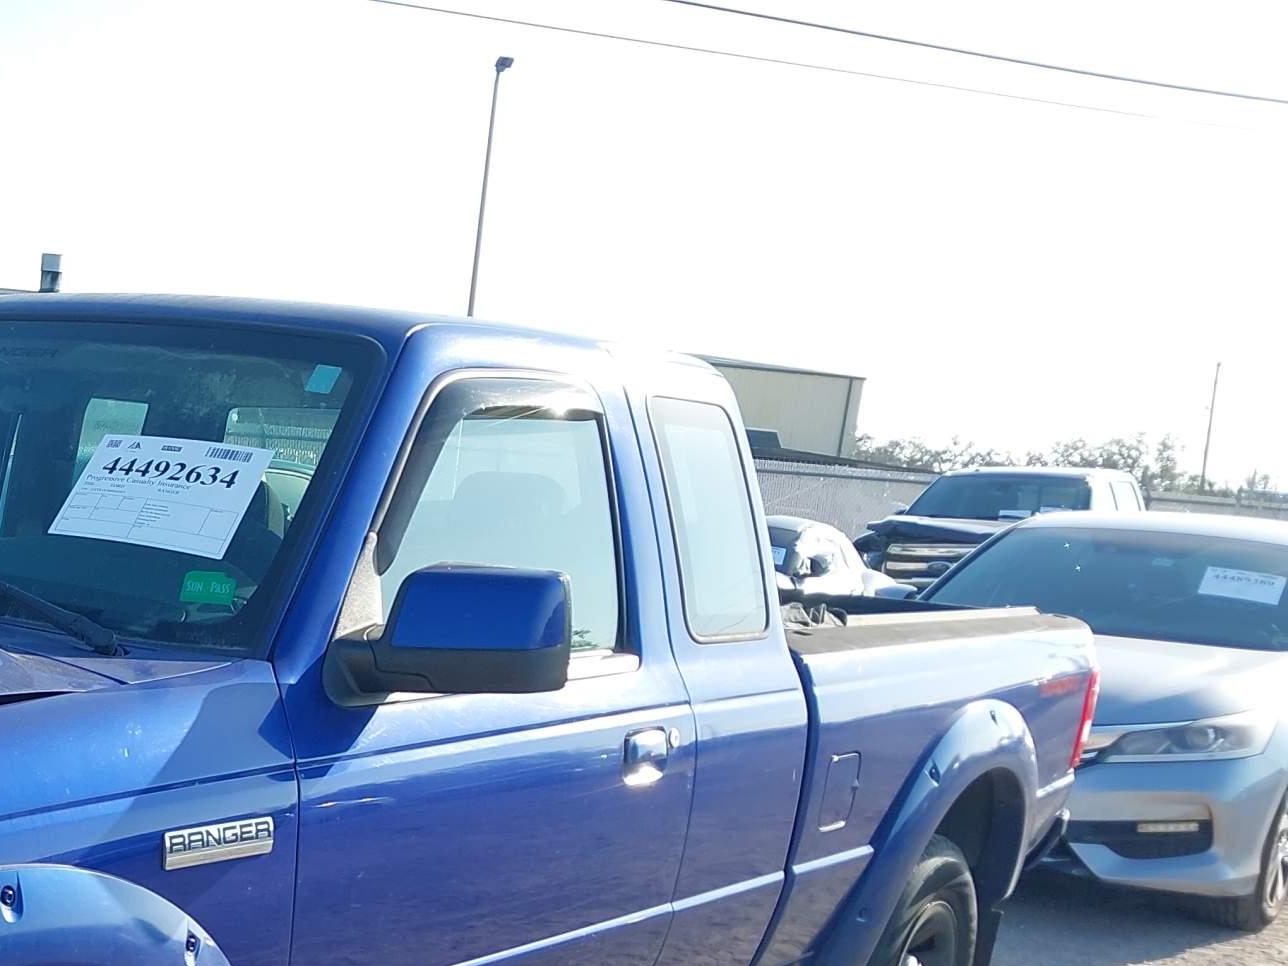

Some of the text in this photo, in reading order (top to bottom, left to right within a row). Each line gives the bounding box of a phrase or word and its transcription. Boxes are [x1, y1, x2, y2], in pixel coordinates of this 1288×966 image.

[102, 456, 240, 489] 44492634
[186, 581, 232, 594] SUN PASS
[168, 820, 272, 854] RANGER
